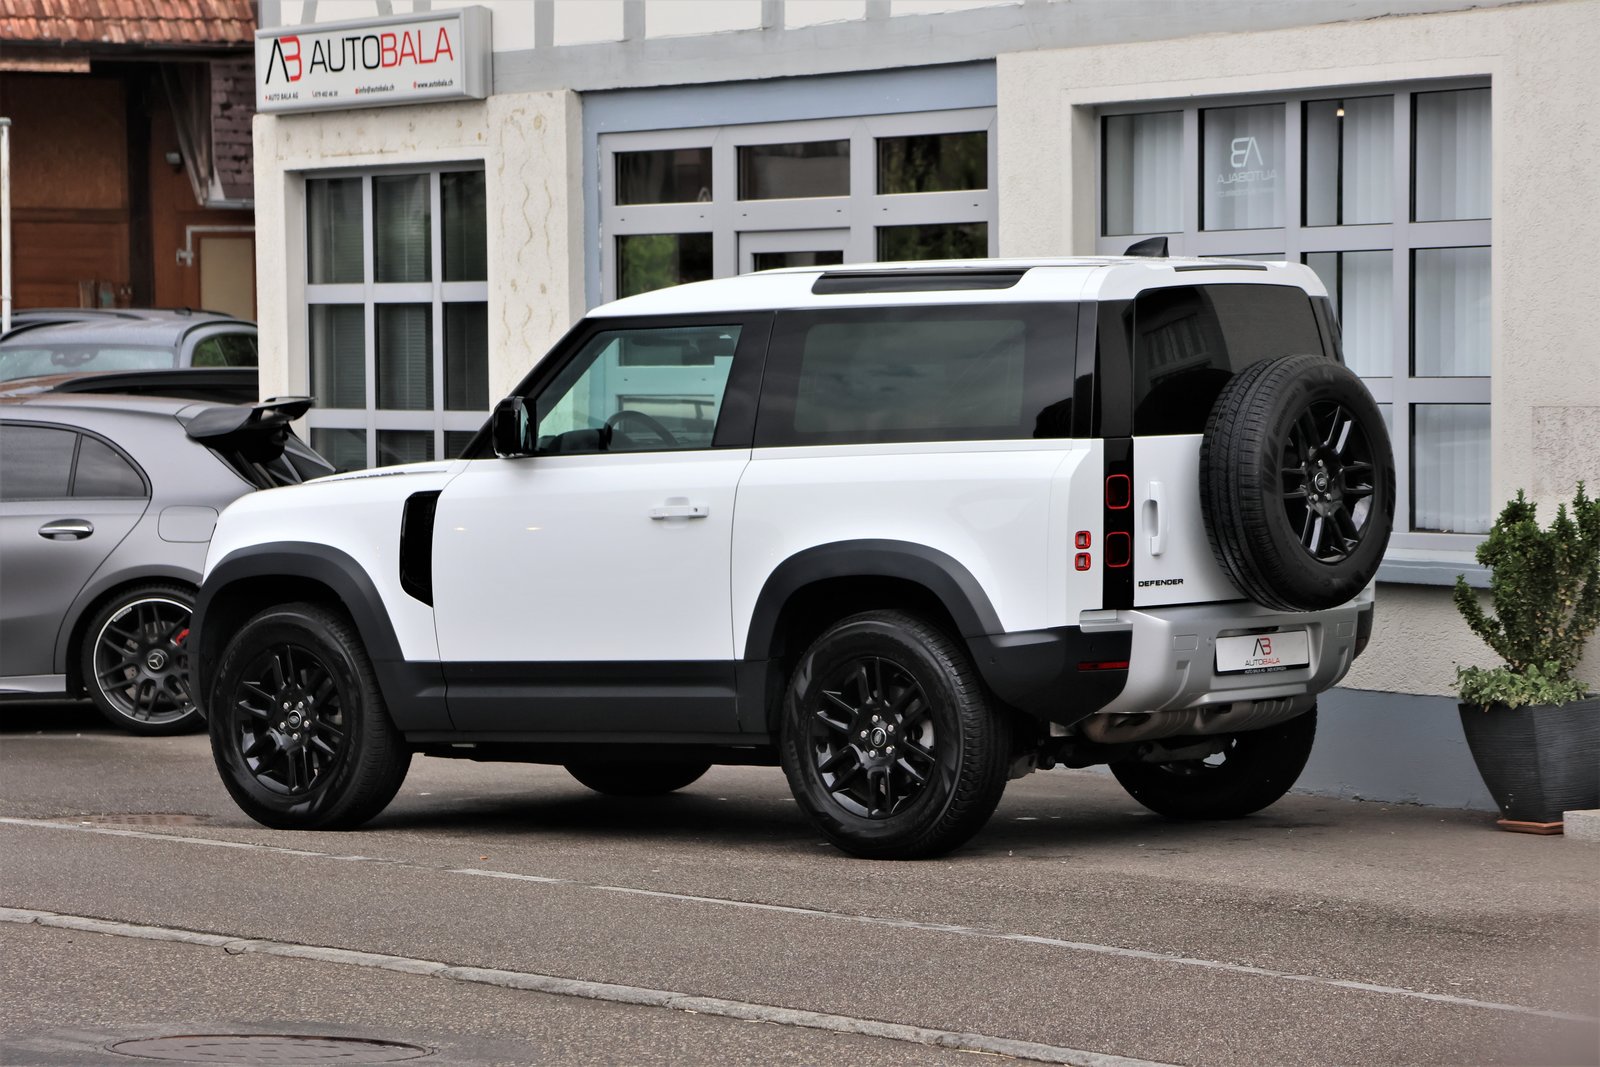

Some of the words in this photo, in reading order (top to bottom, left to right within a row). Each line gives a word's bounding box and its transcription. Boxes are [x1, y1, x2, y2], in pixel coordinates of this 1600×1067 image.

[309, 27, 454, 74] AUTOBALA
[268, 93, 280, 101] AUTO
[281, 92, 292, 100] BALA
[1138, 578, 1184, 587] DEFENDER
[1245, 658, 1280, 667] AUTOBALA
